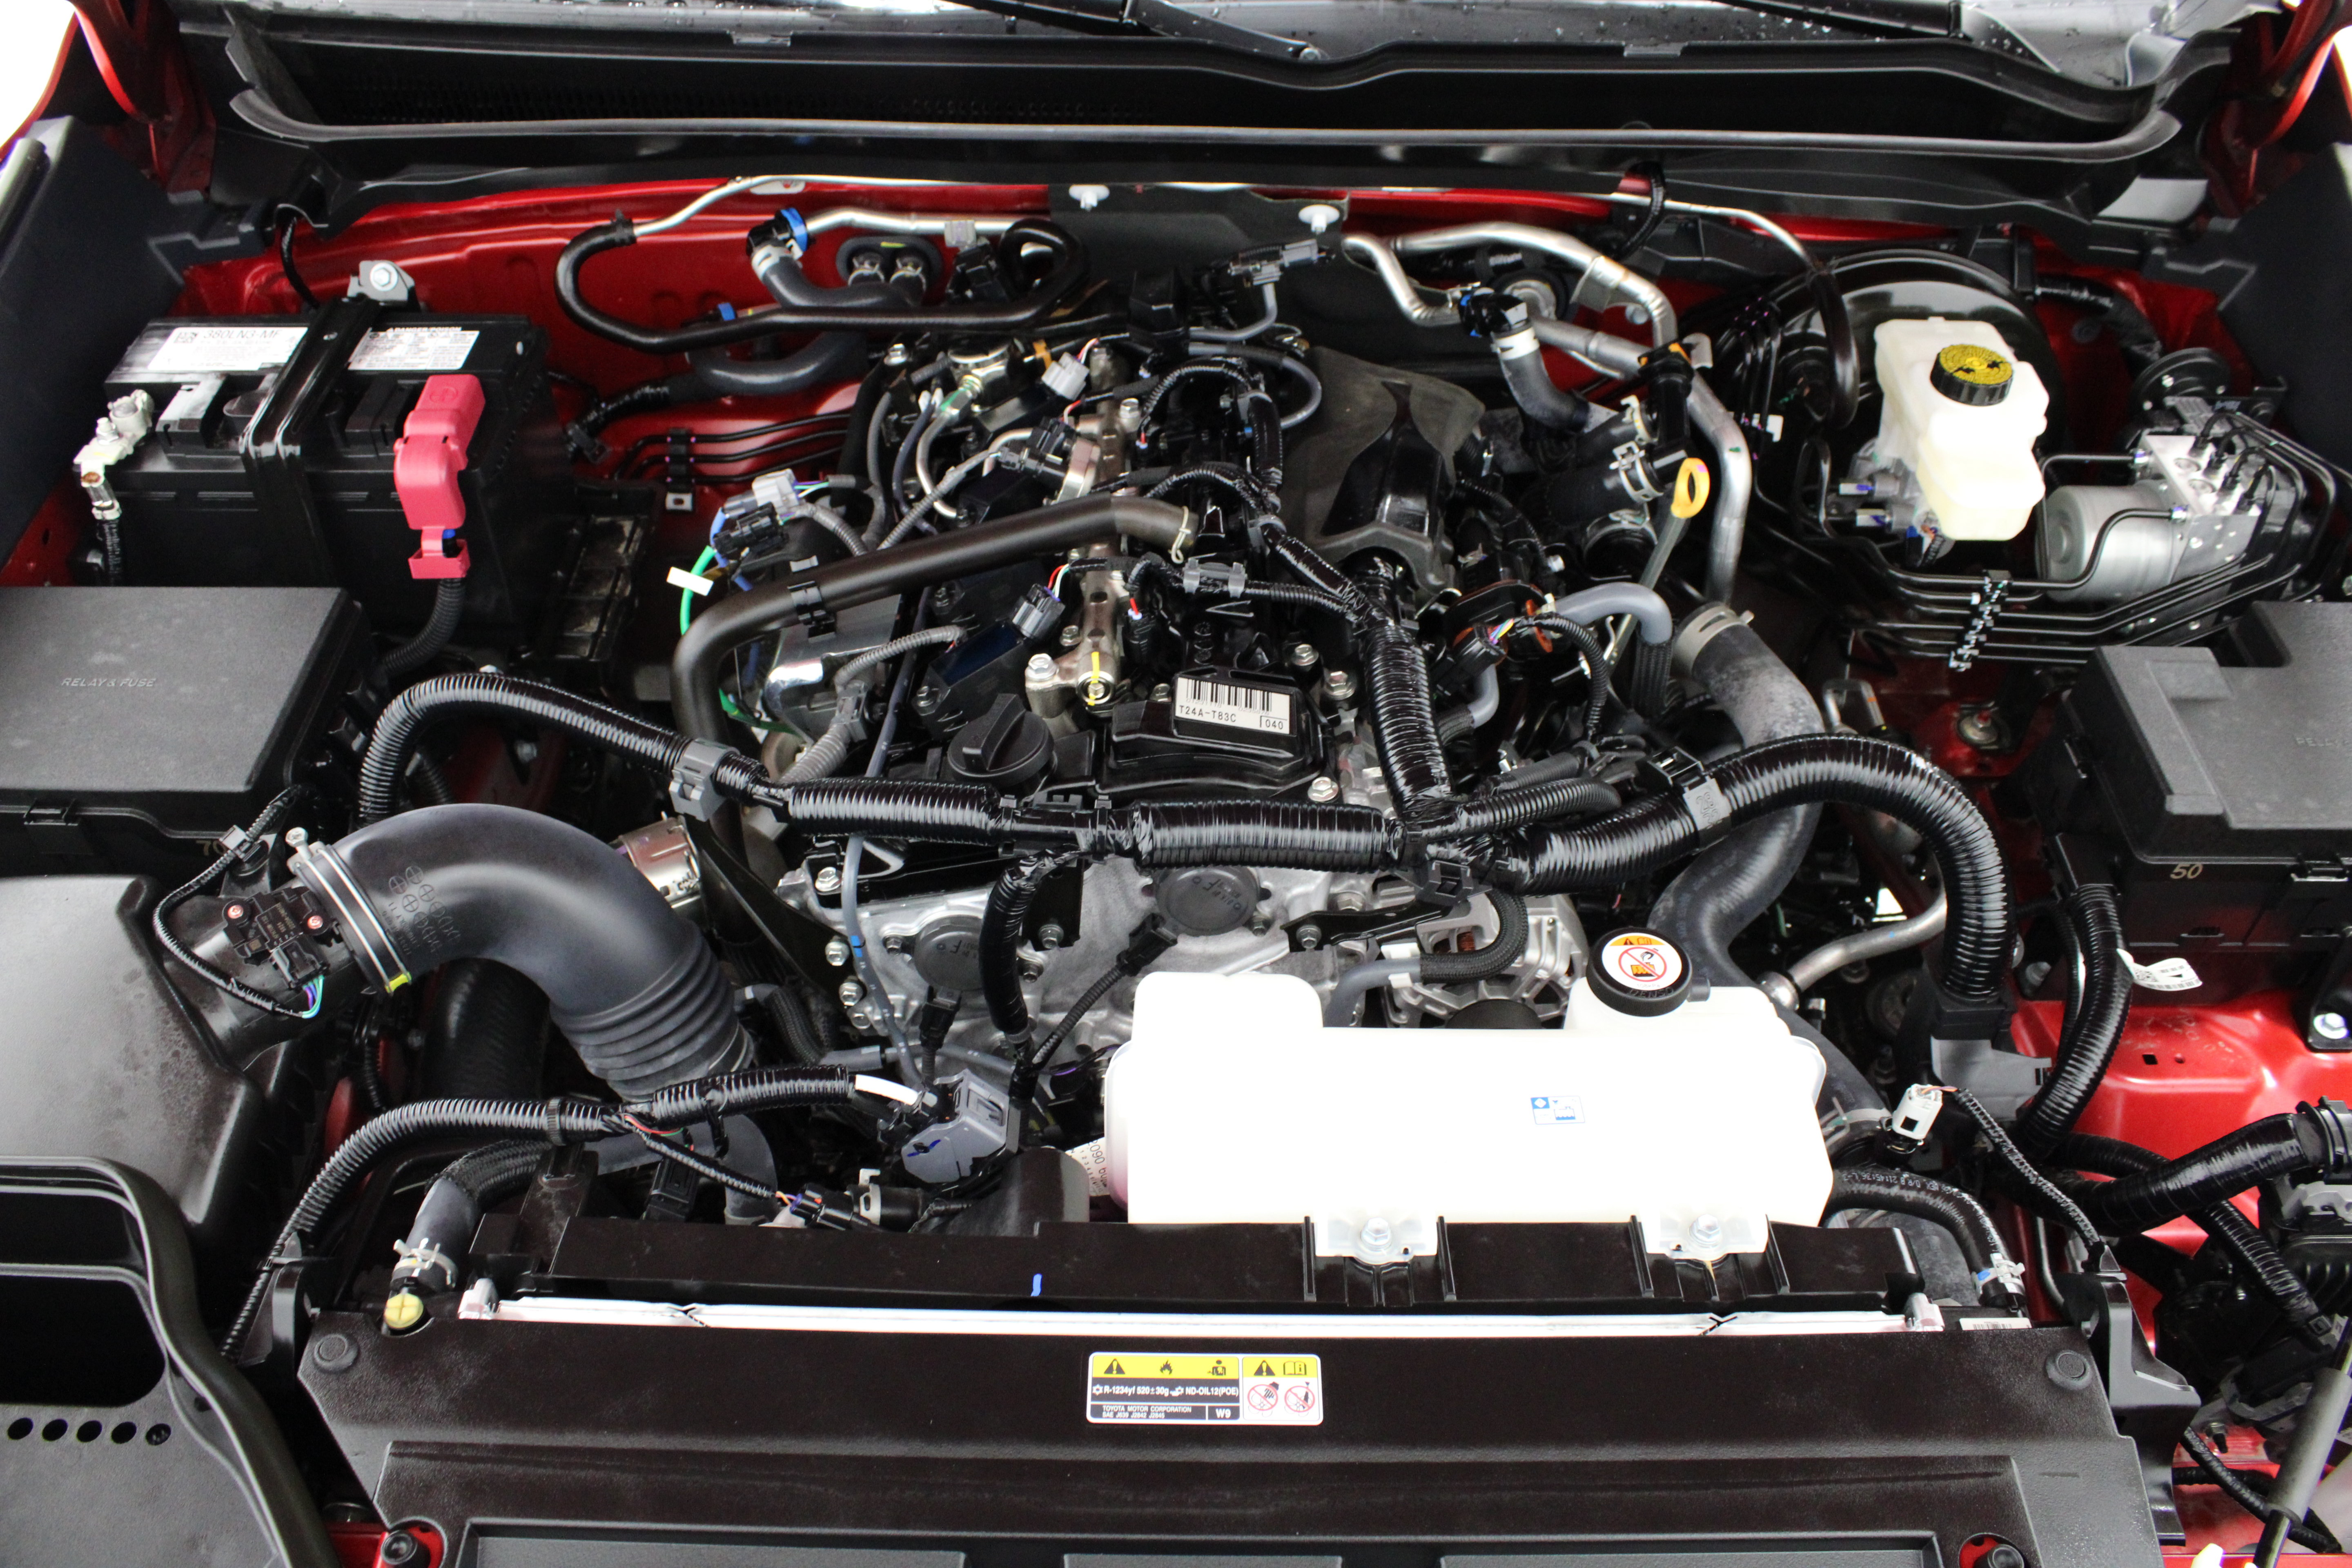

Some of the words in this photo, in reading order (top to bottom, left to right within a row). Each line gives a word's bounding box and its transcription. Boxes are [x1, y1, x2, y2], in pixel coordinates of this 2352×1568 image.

[61, 678, 106, 687] RELAY
[107, 678, 116, 687] &
[119, 678, 157, 687] FUSE
[1179, 705, 1236, 722] T24A-T83C
[2170, 864, 2203, 879] 50
[1104, 1385, 1135, 1396] R-1234yf
[1185, 1386, 1239, 1397] ND-OIL12(POE)
[1215, 1408, 1232, 1419] W9
